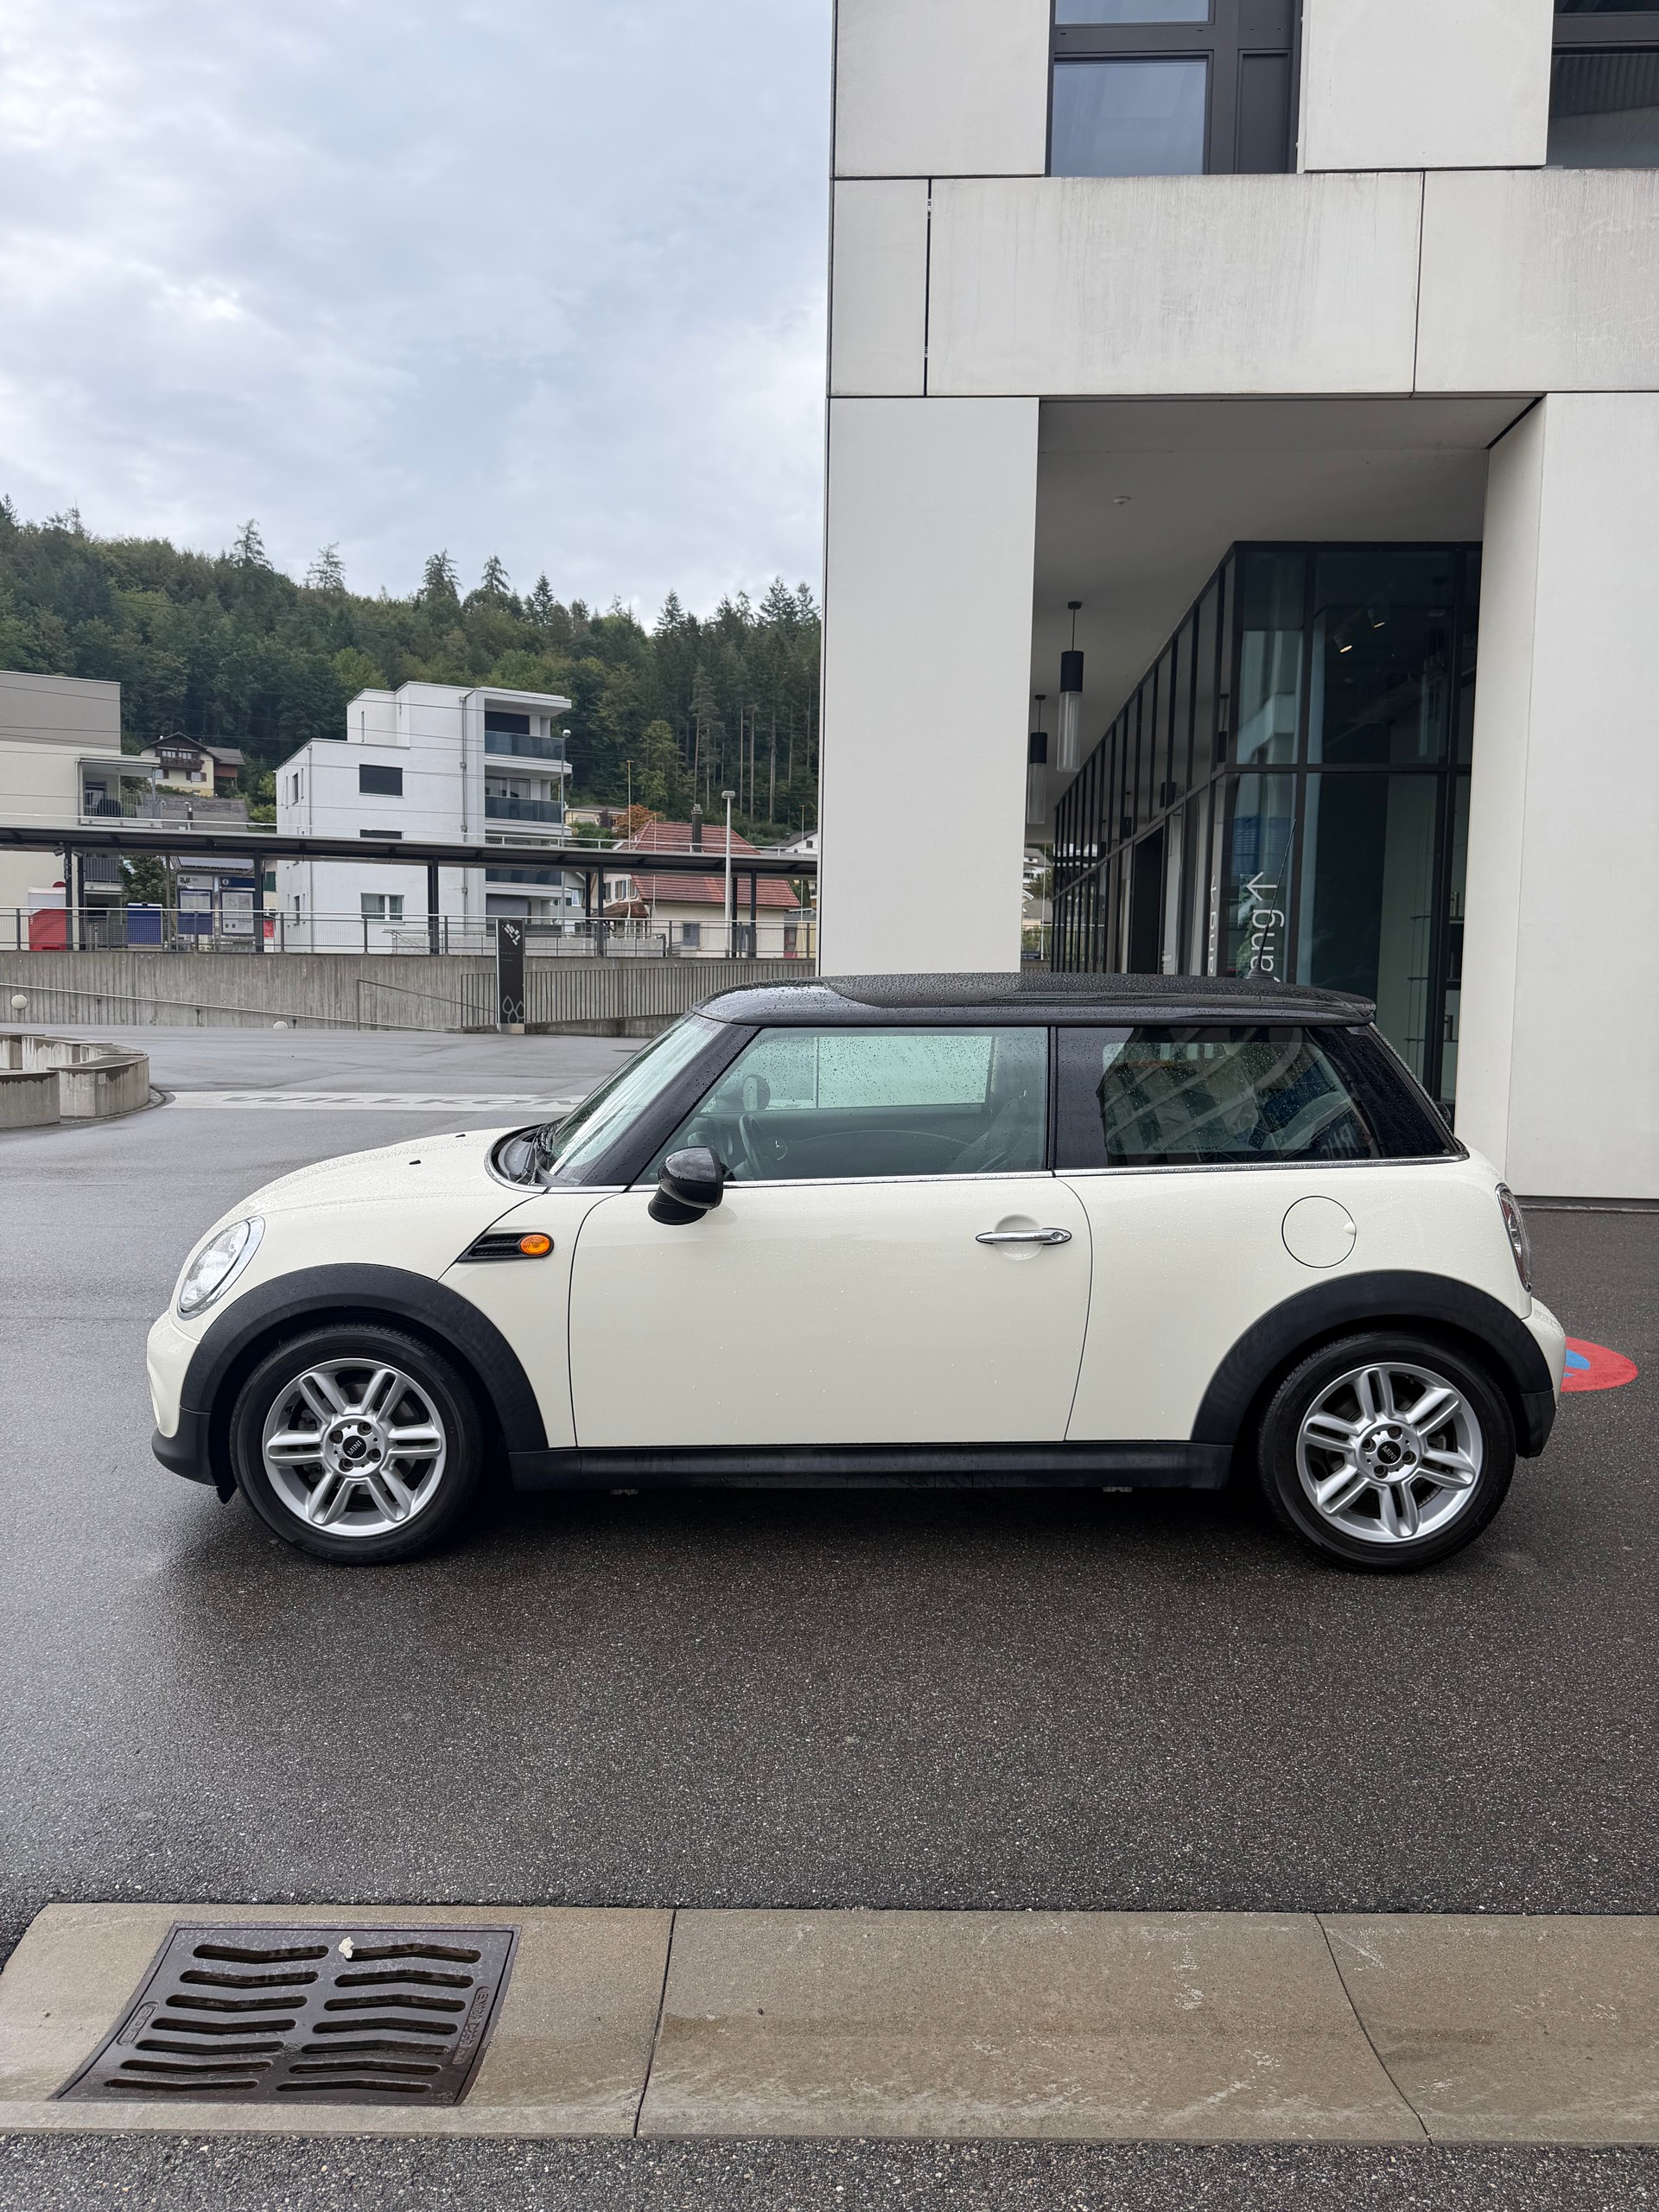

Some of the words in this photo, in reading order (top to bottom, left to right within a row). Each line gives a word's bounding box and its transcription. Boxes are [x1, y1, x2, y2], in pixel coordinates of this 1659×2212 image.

[1248, 909, 1285, 982] ang
[347, 1440, 363, 1455] MINI
[1382, 1445, 1397, 1460] MINI
